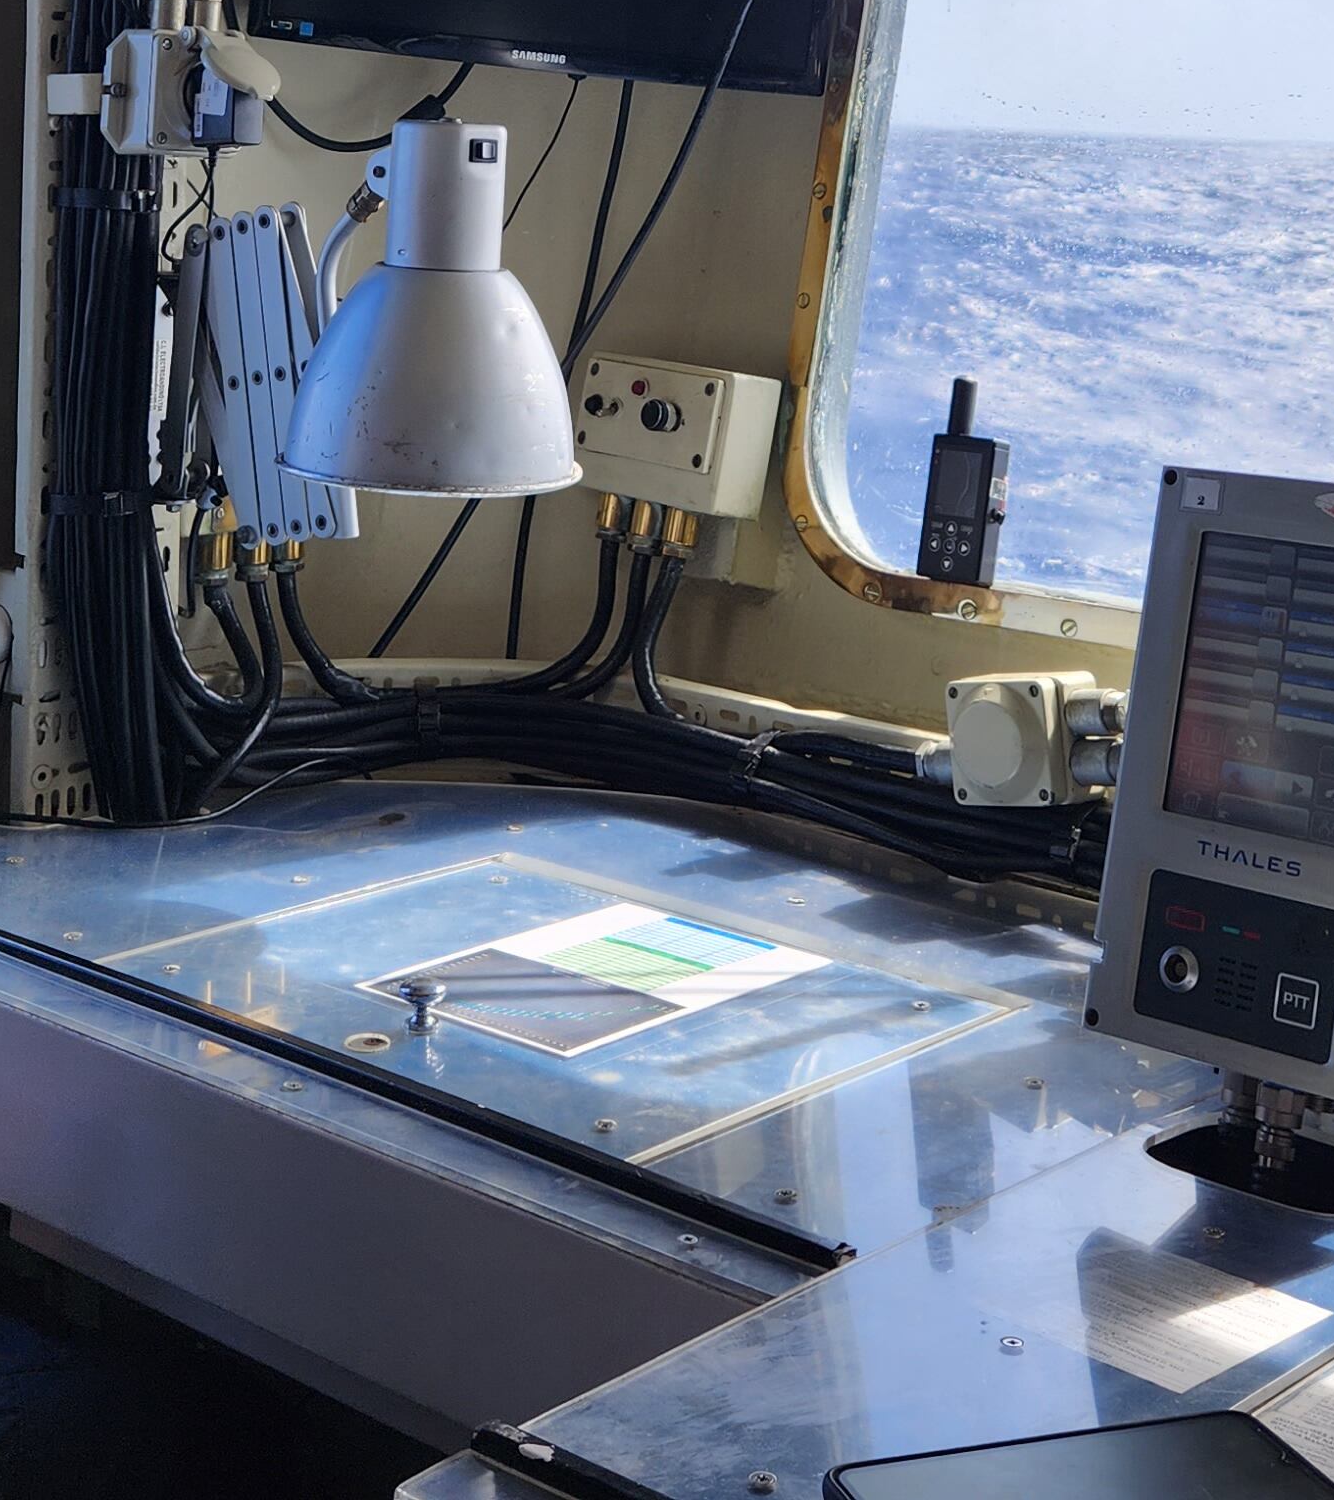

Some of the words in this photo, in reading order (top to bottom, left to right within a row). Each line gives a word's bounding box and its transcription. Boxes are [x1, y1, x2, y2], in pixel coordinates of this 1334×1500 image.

[511, 49, 567, 65] SAMSUNG
[1196, 495, 1205, 505] 2
[1197, 840, 1302, 877] THALES
[1282, 990, 1312, 1011] PTT
